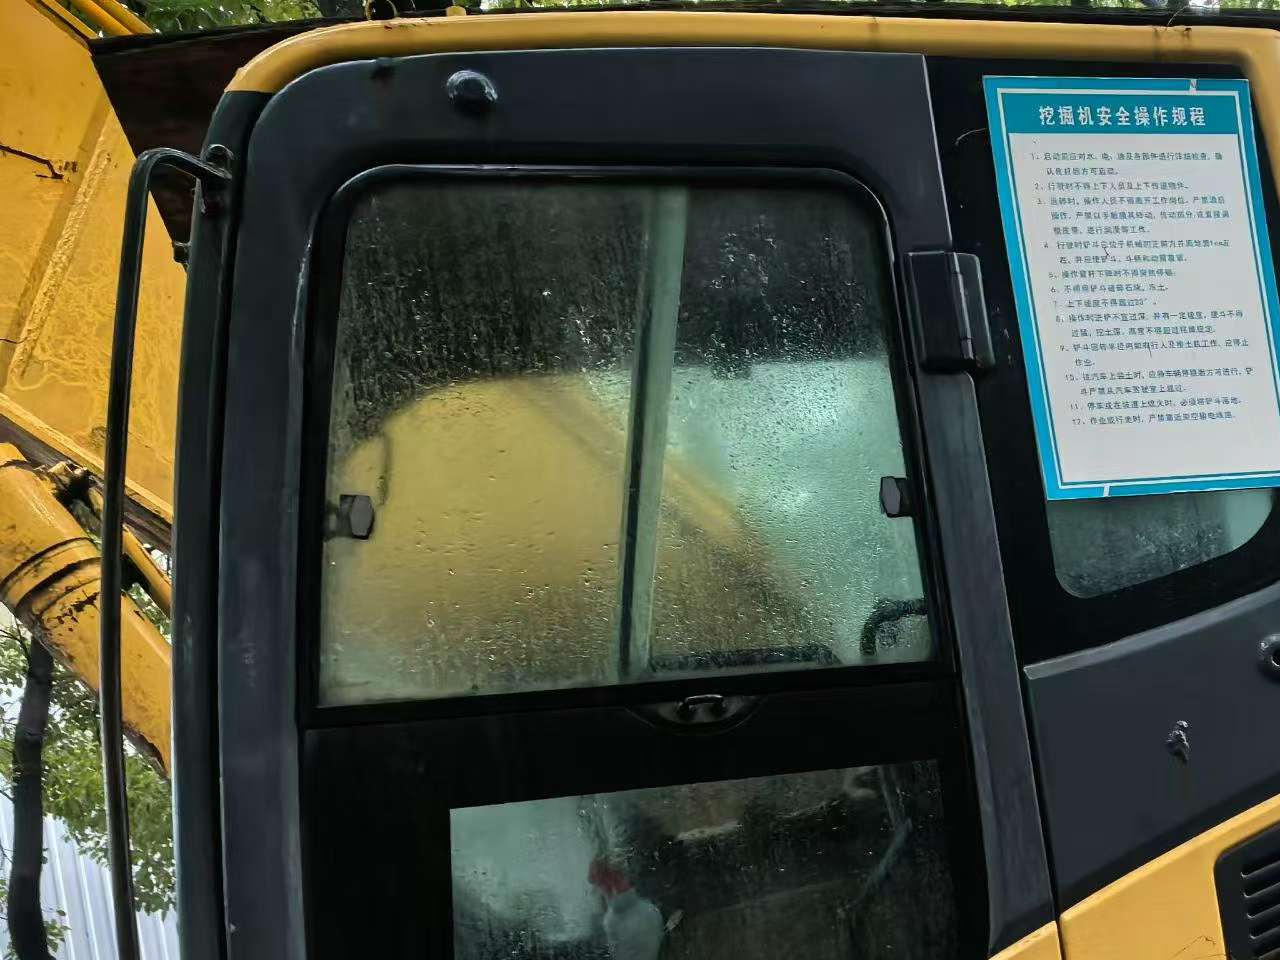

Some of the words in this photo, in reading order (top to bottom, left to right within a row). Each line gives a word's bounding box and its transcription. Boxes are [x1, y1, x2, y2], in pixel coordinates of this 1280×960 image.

[1038, 105, 1207, 127] 挖掘机安全操作规程
